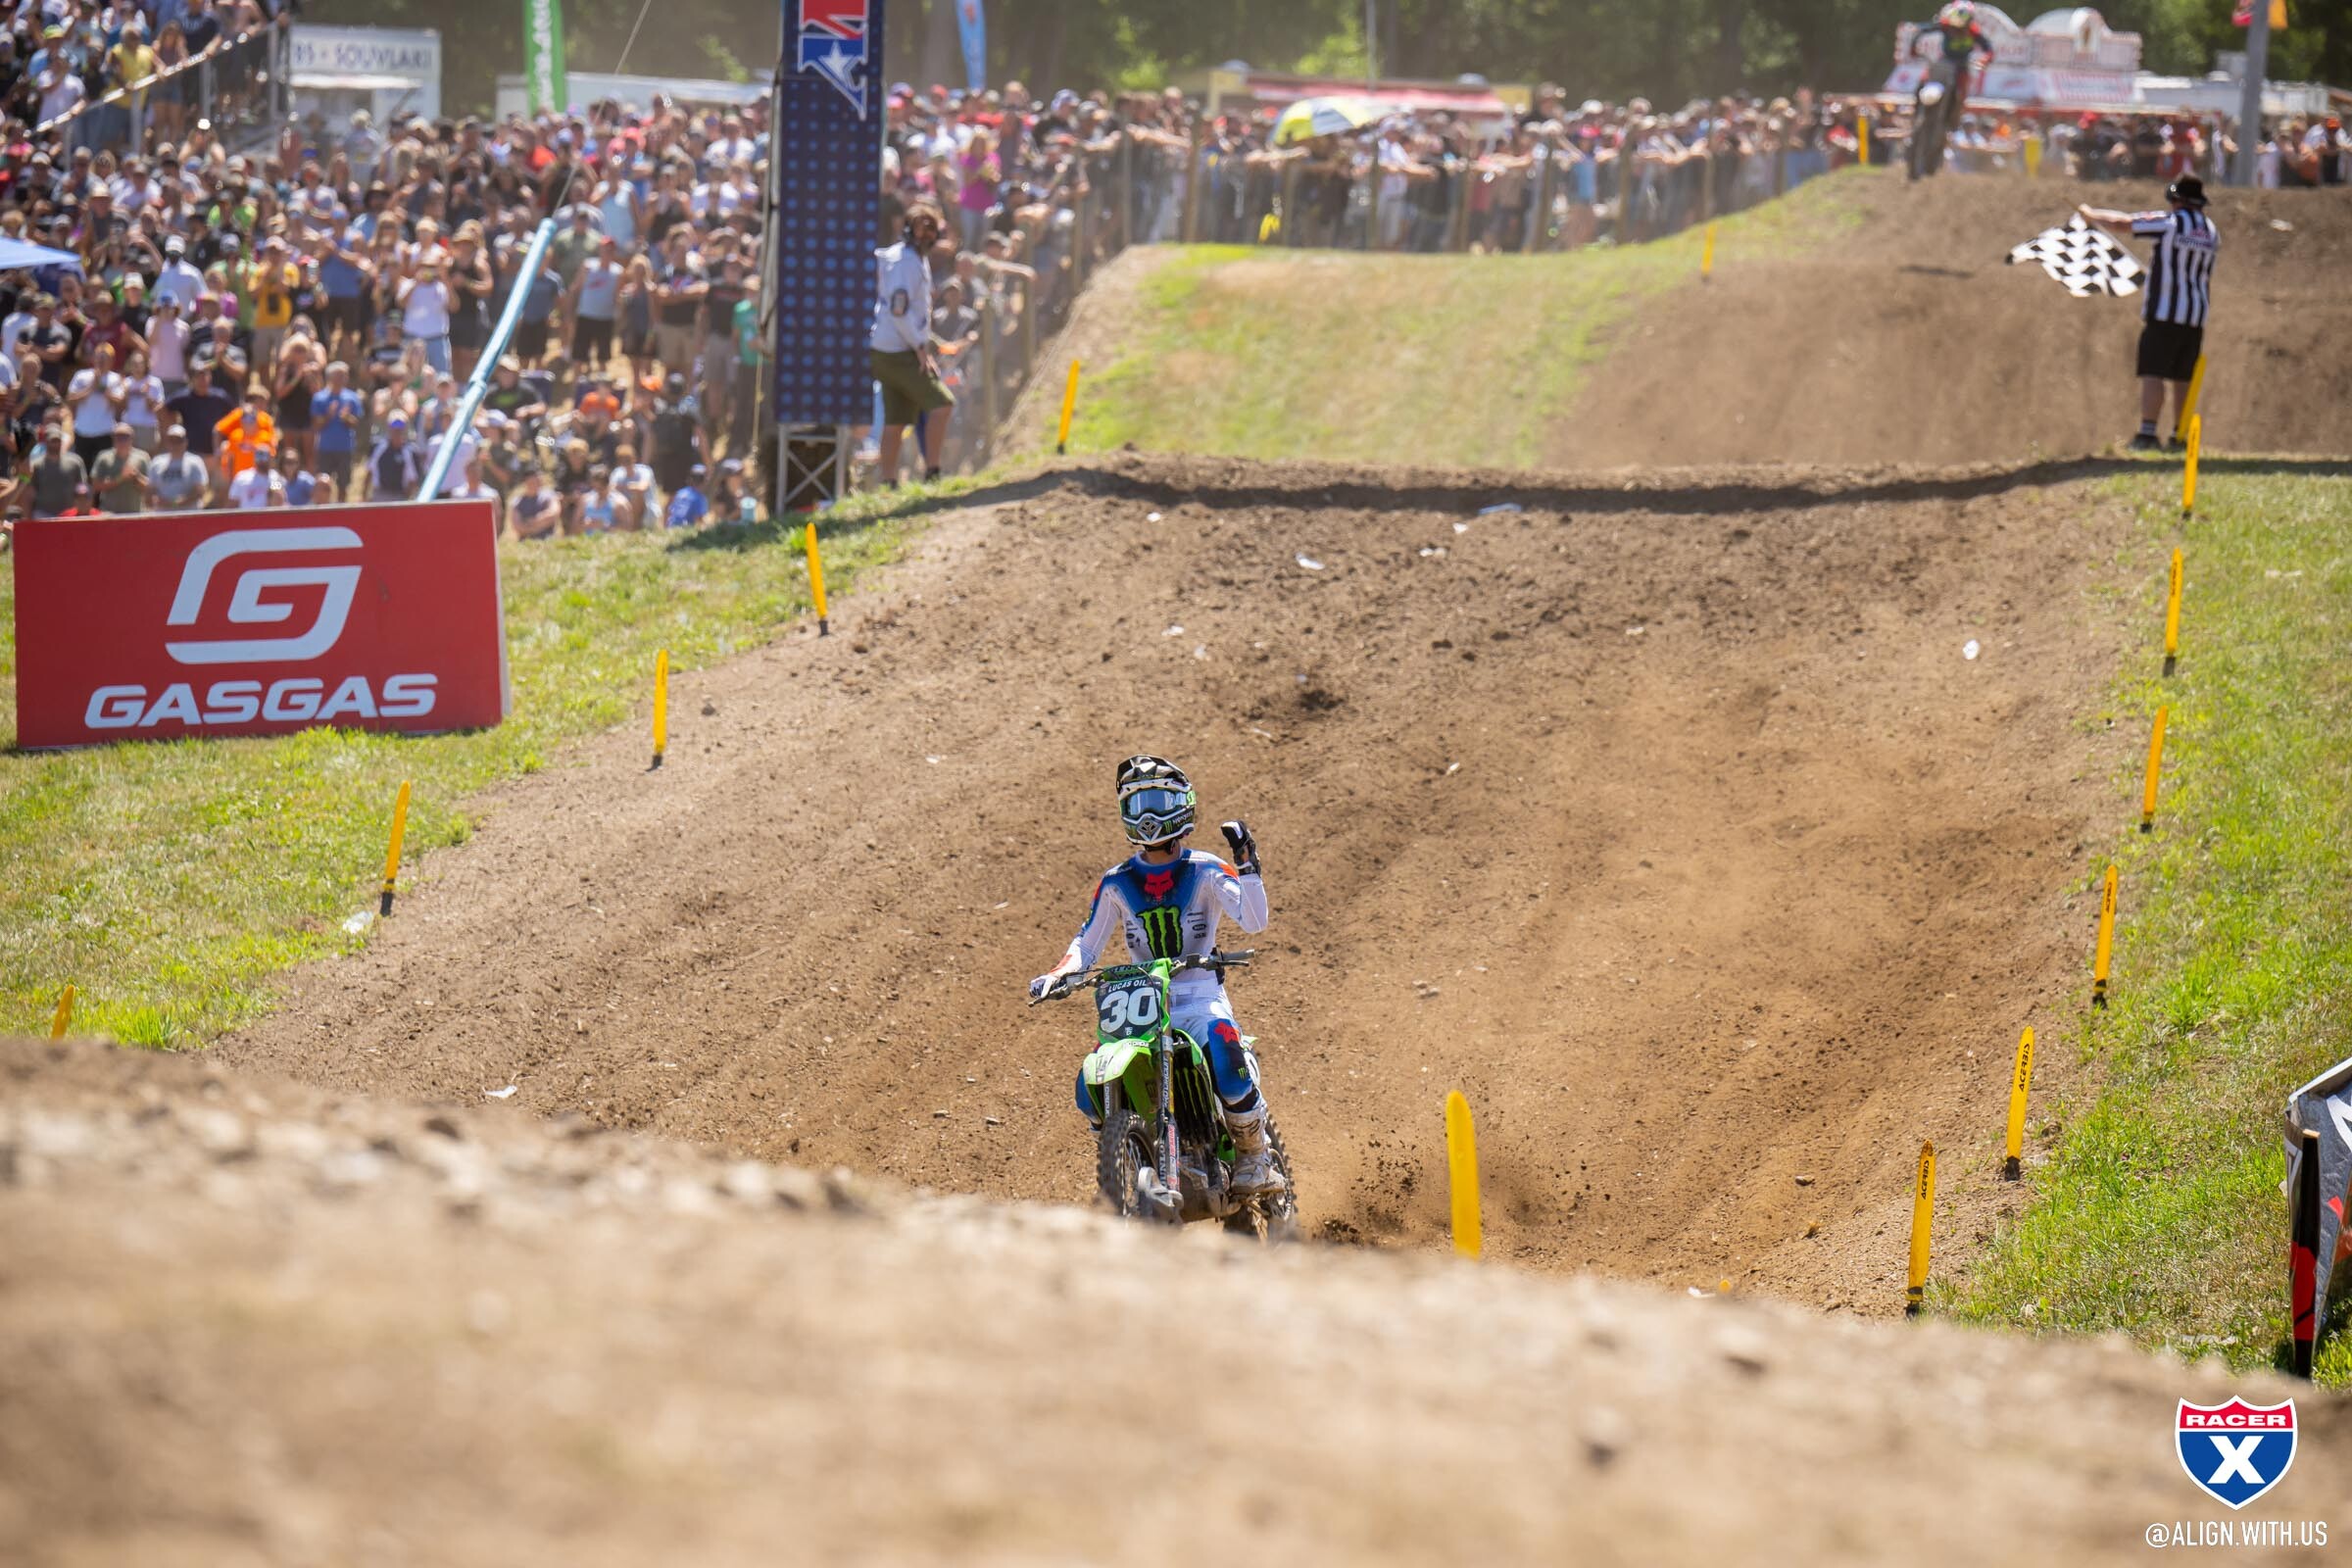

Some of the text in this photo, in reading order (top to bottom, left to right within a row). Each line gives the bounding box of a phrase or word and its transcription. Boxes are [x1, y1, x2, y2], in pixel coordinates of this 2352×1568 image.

[334, 43, 433, 69] SOUVLAKI
[84, 673, 438, 729] GASGAS
[1107, 980, 1132, 993] LUCAS
[1100, 987, 1162, 1034] 30
[2019, 1043, 2031, 1092] ACERBIS
[1921, 1159, 1930, 1200] ACERBIS
